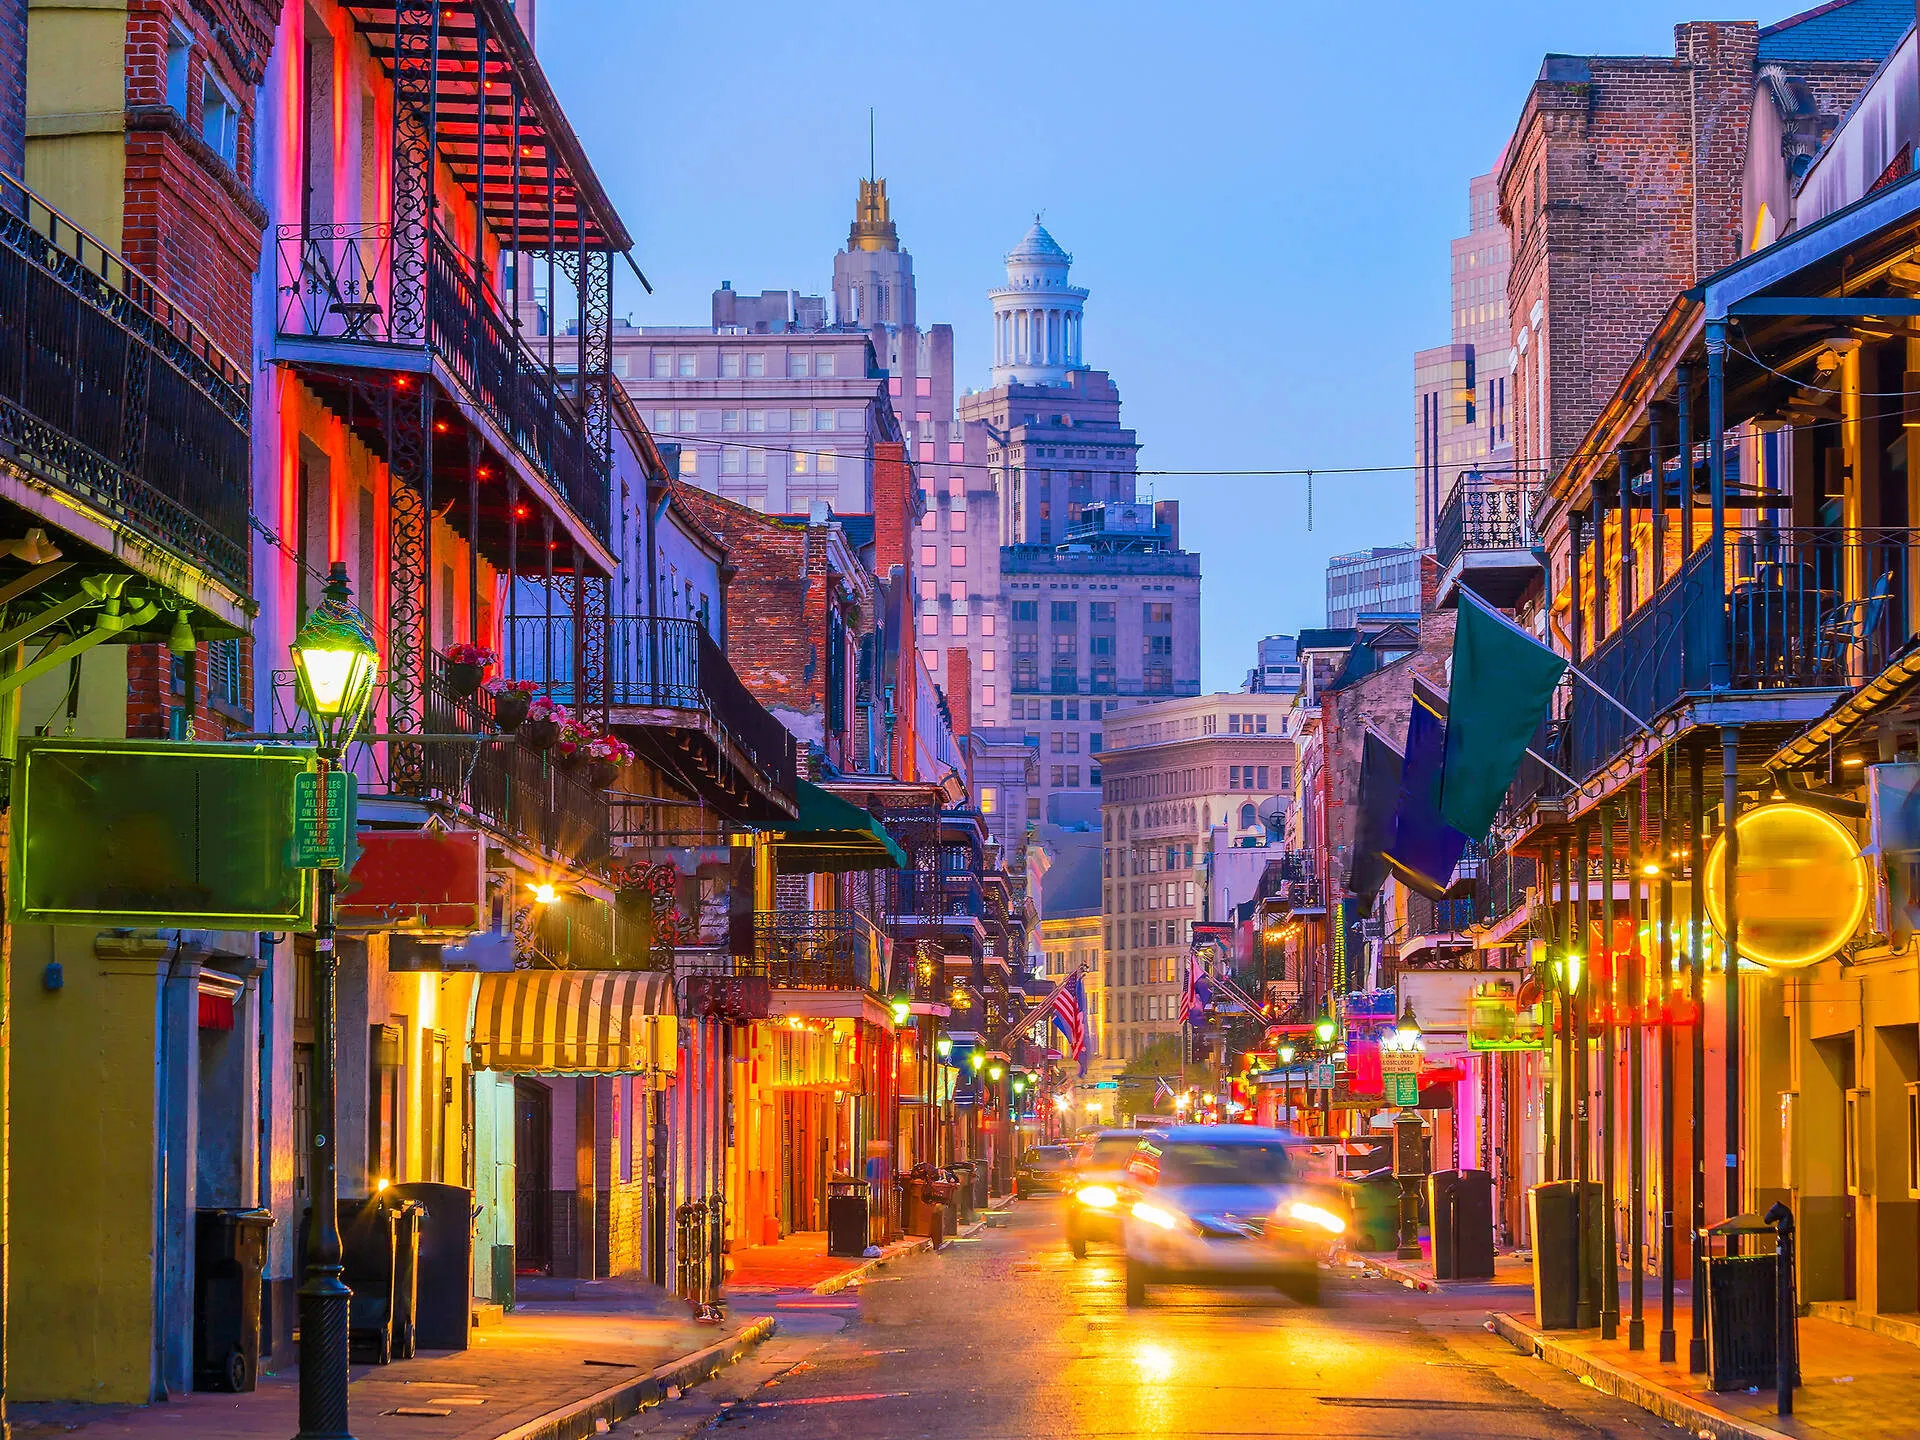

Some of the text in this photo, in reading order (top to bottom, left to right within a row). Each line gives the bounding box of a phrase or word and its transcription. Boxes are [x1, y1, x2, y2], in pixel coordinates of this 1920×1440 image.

[300, 781, 310, 789] NO
[304, 790, 313, 798] OR
[305, 799, 336, 807] ALLED
[301, 808, 338, 816] ON SEET
